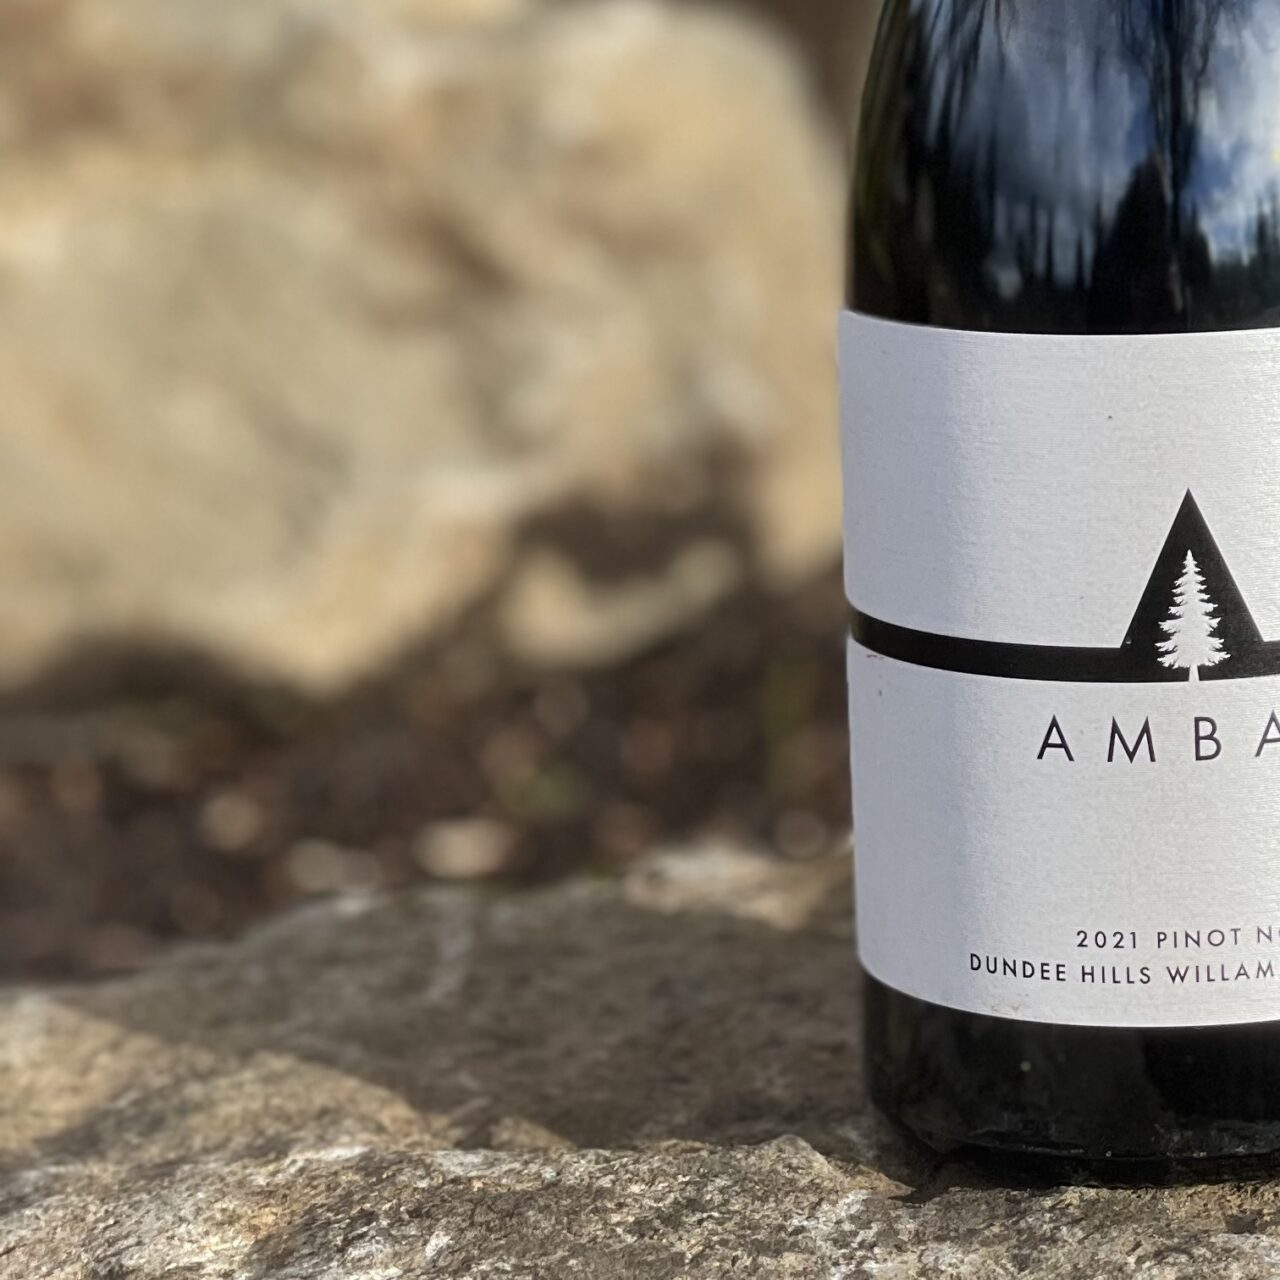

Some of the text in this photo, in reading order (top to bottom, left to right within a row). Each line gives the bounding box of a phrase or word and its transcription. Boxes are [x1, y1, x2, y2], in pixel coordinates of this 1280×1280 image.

[1076, 929, 1137, 950] 2021
[1156, 927, 1242, 950] PINOT
[969, 952, 1068, 982] DUNDEE
[1081, 964, 1151, 985] HILLS
